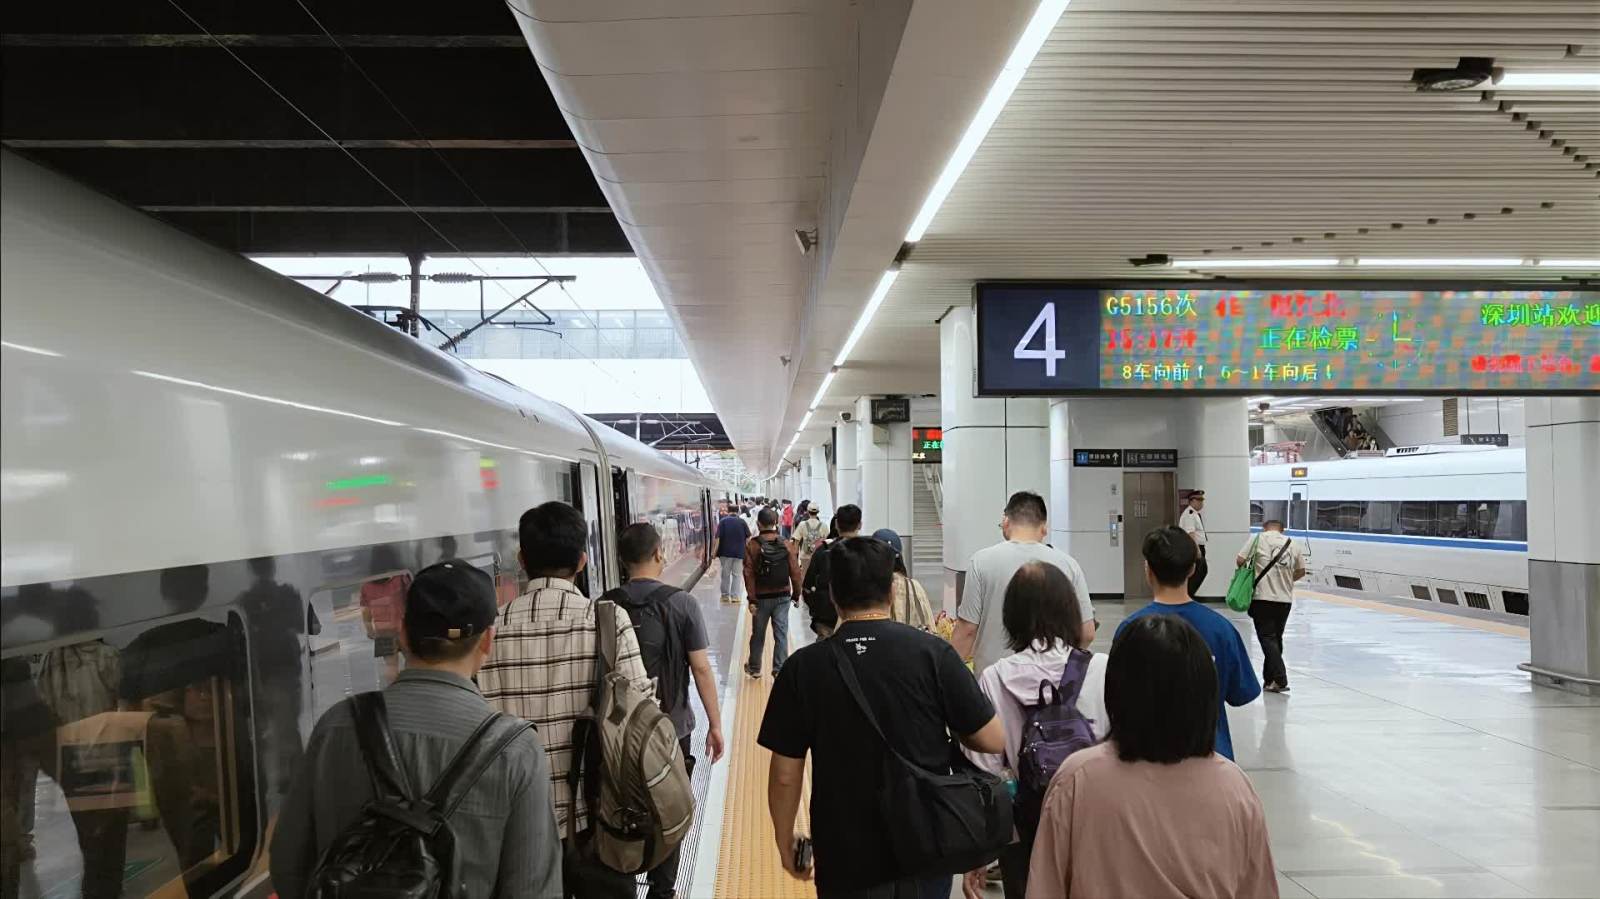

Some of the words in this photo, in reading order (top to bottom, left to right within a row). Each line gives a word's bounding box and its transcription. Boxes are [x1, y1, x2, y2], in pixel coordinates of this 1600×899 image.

[1106, 294, 1198, 317] G5156次
[1481, 303, 1600, 328] 深圳站欢迎
[1014, 302, 1066, 376] 4
[1258, 325, 1359, 351] 正在检票
[1122, 362, 1190, 382] 8车向前
